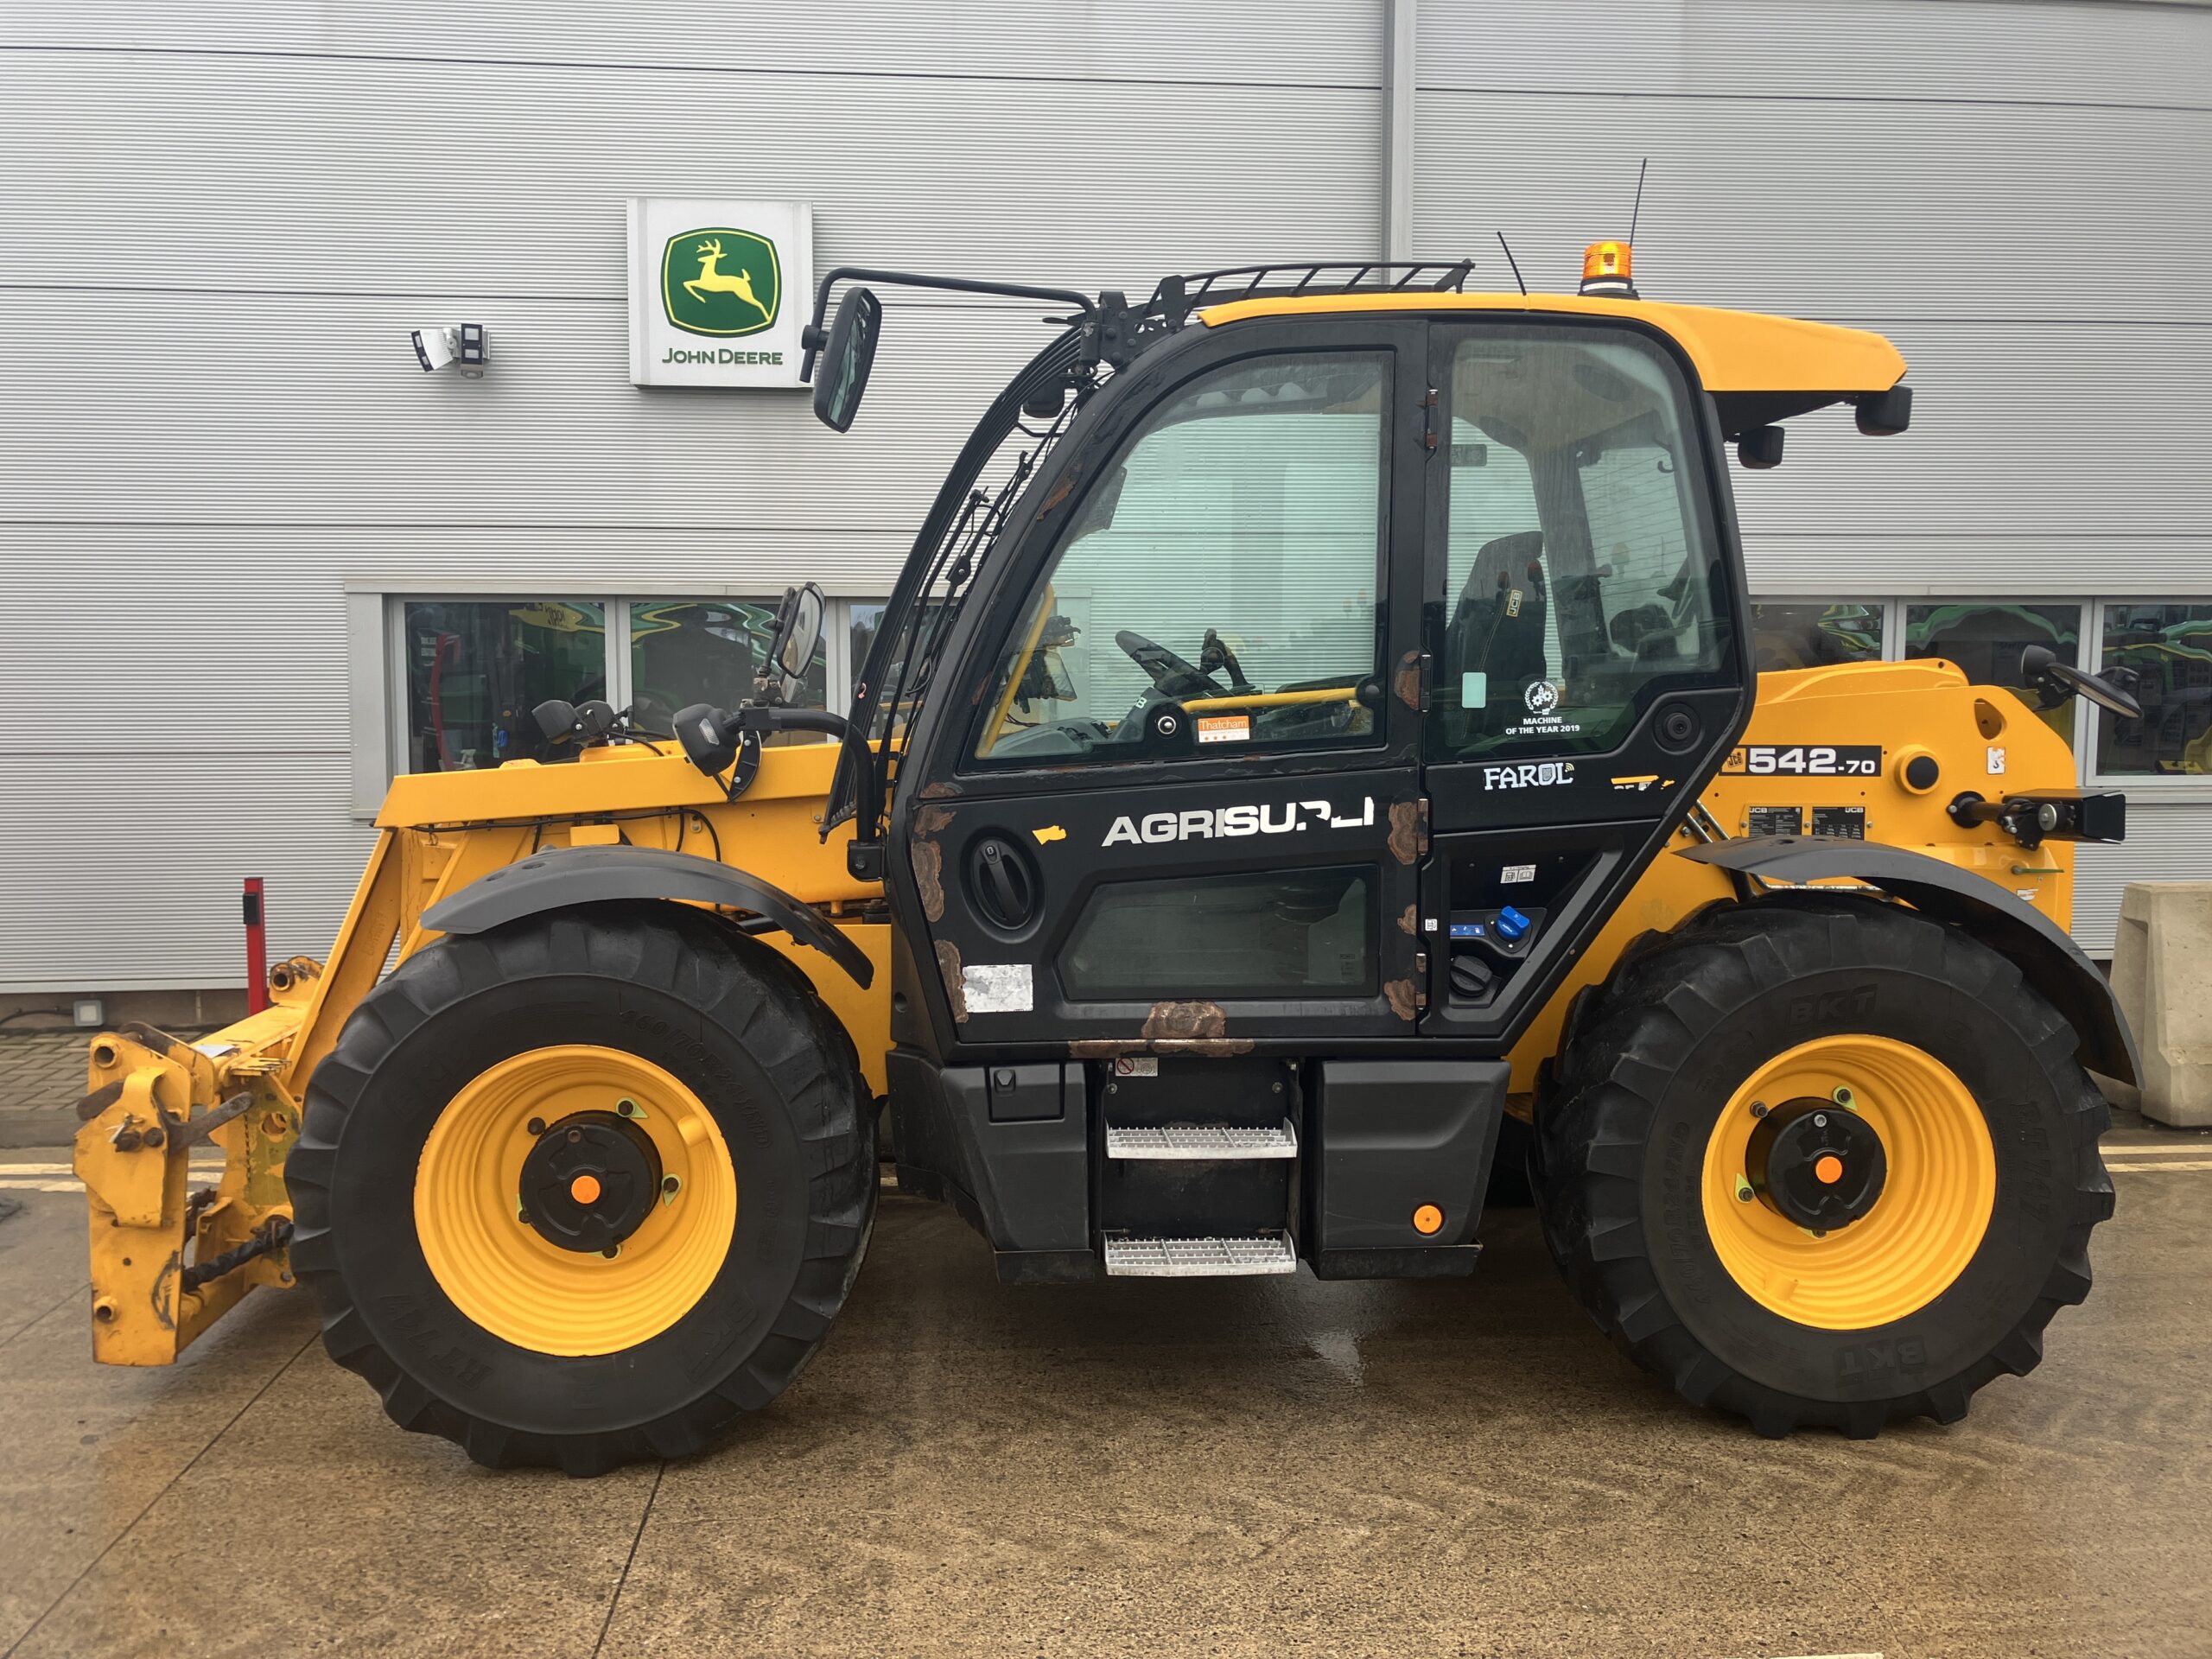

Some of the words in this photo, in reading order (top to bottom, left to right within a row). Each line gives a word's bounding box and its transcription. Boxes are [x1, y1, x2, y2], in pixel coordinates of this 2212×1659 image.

[662, 347, 715, 364] JOHN
[718, 348, 783, 365] DEERE
[1510, 592, 1520, 615] JCB
[1199, 719, 1247, 730] Thatcham
[1522, 716, 1563, 725] MACHINE
[1537, 725, 1559, 734] YEAR
[1727, 753, 1744, 768] JCB
[1484, 762, 1574, 791] FAROL
[1788, 988, 1877, 1026] BKT
[1838, 1339, 1926, 1377] BKT
